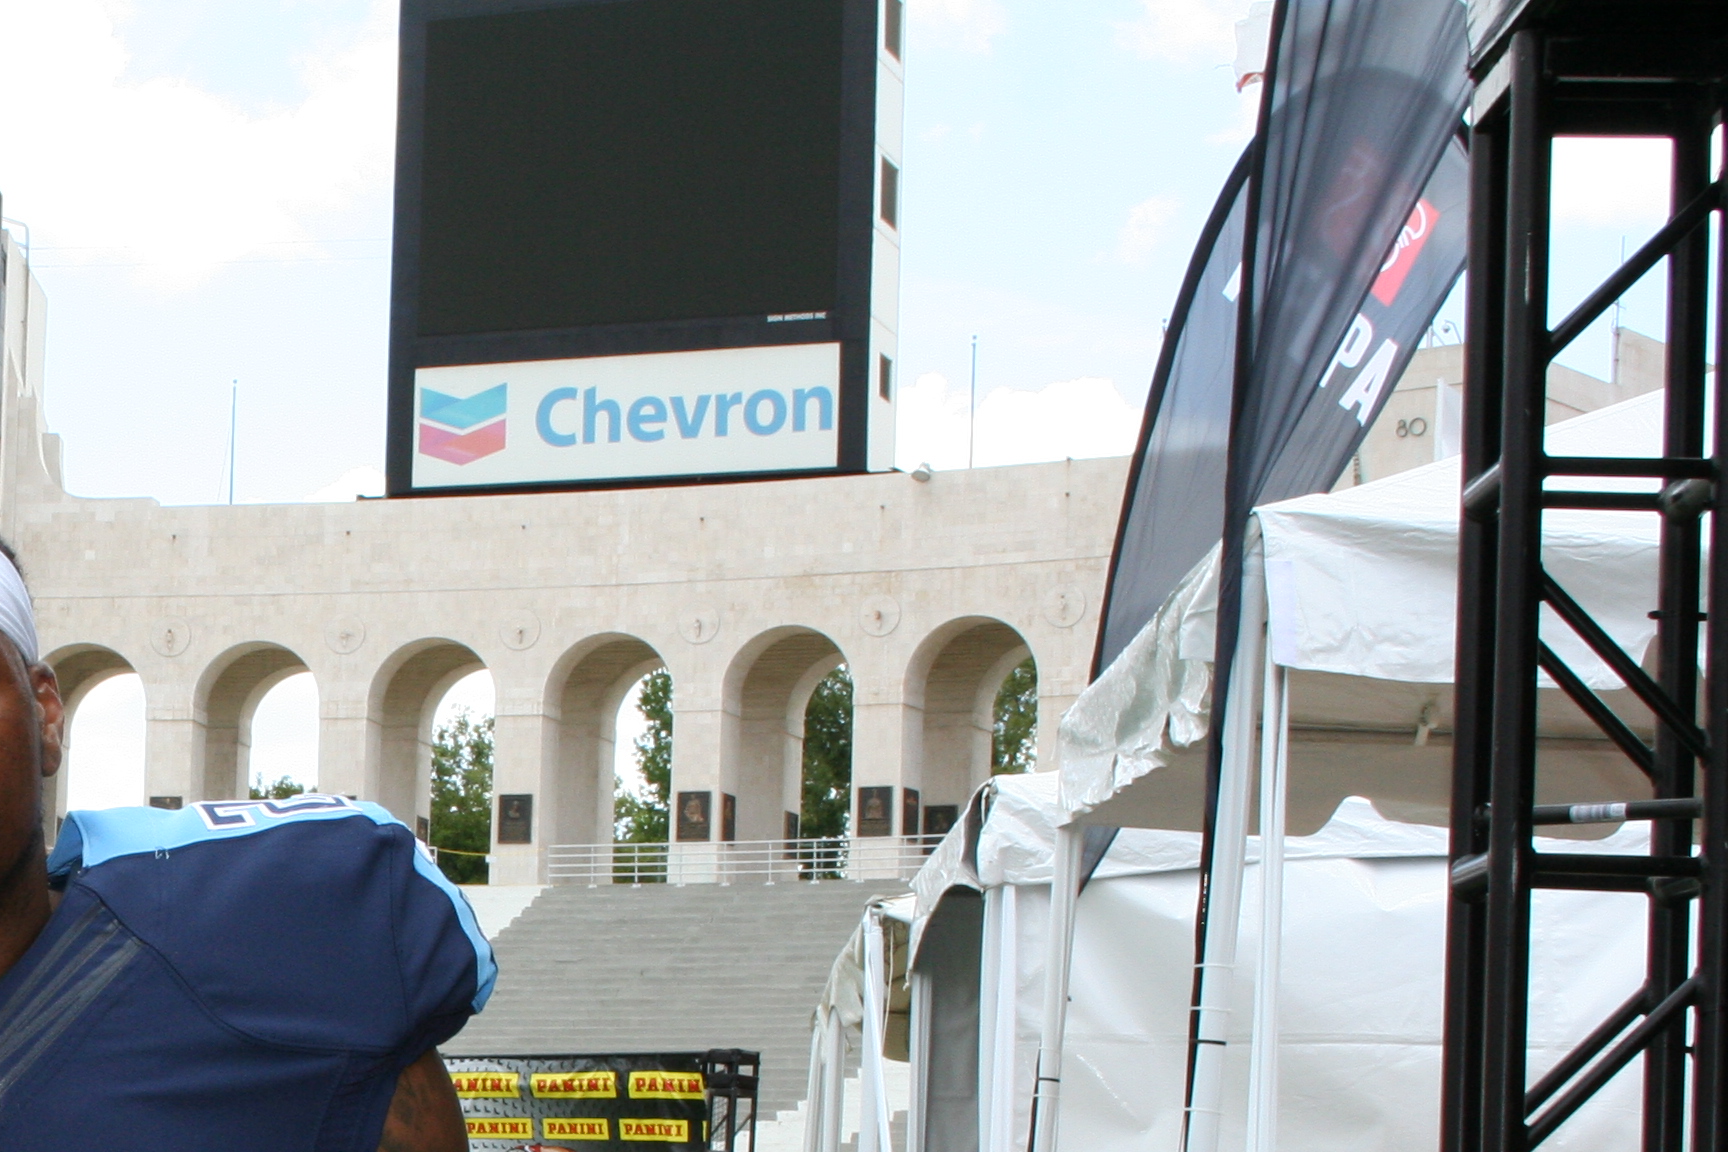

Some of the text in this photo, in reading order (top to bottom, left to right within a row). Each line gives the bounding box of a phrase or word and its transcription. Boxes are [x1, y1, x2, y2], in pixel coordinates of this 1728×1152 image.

[535, 385, 833, 447] Chevron
[1395, 416, 1427, 438] 80
[453, 1077, 701, 1092] ANINI PANINI PANIN
[466, 1122, 683, 1136] PANINI PANINI PANINI
